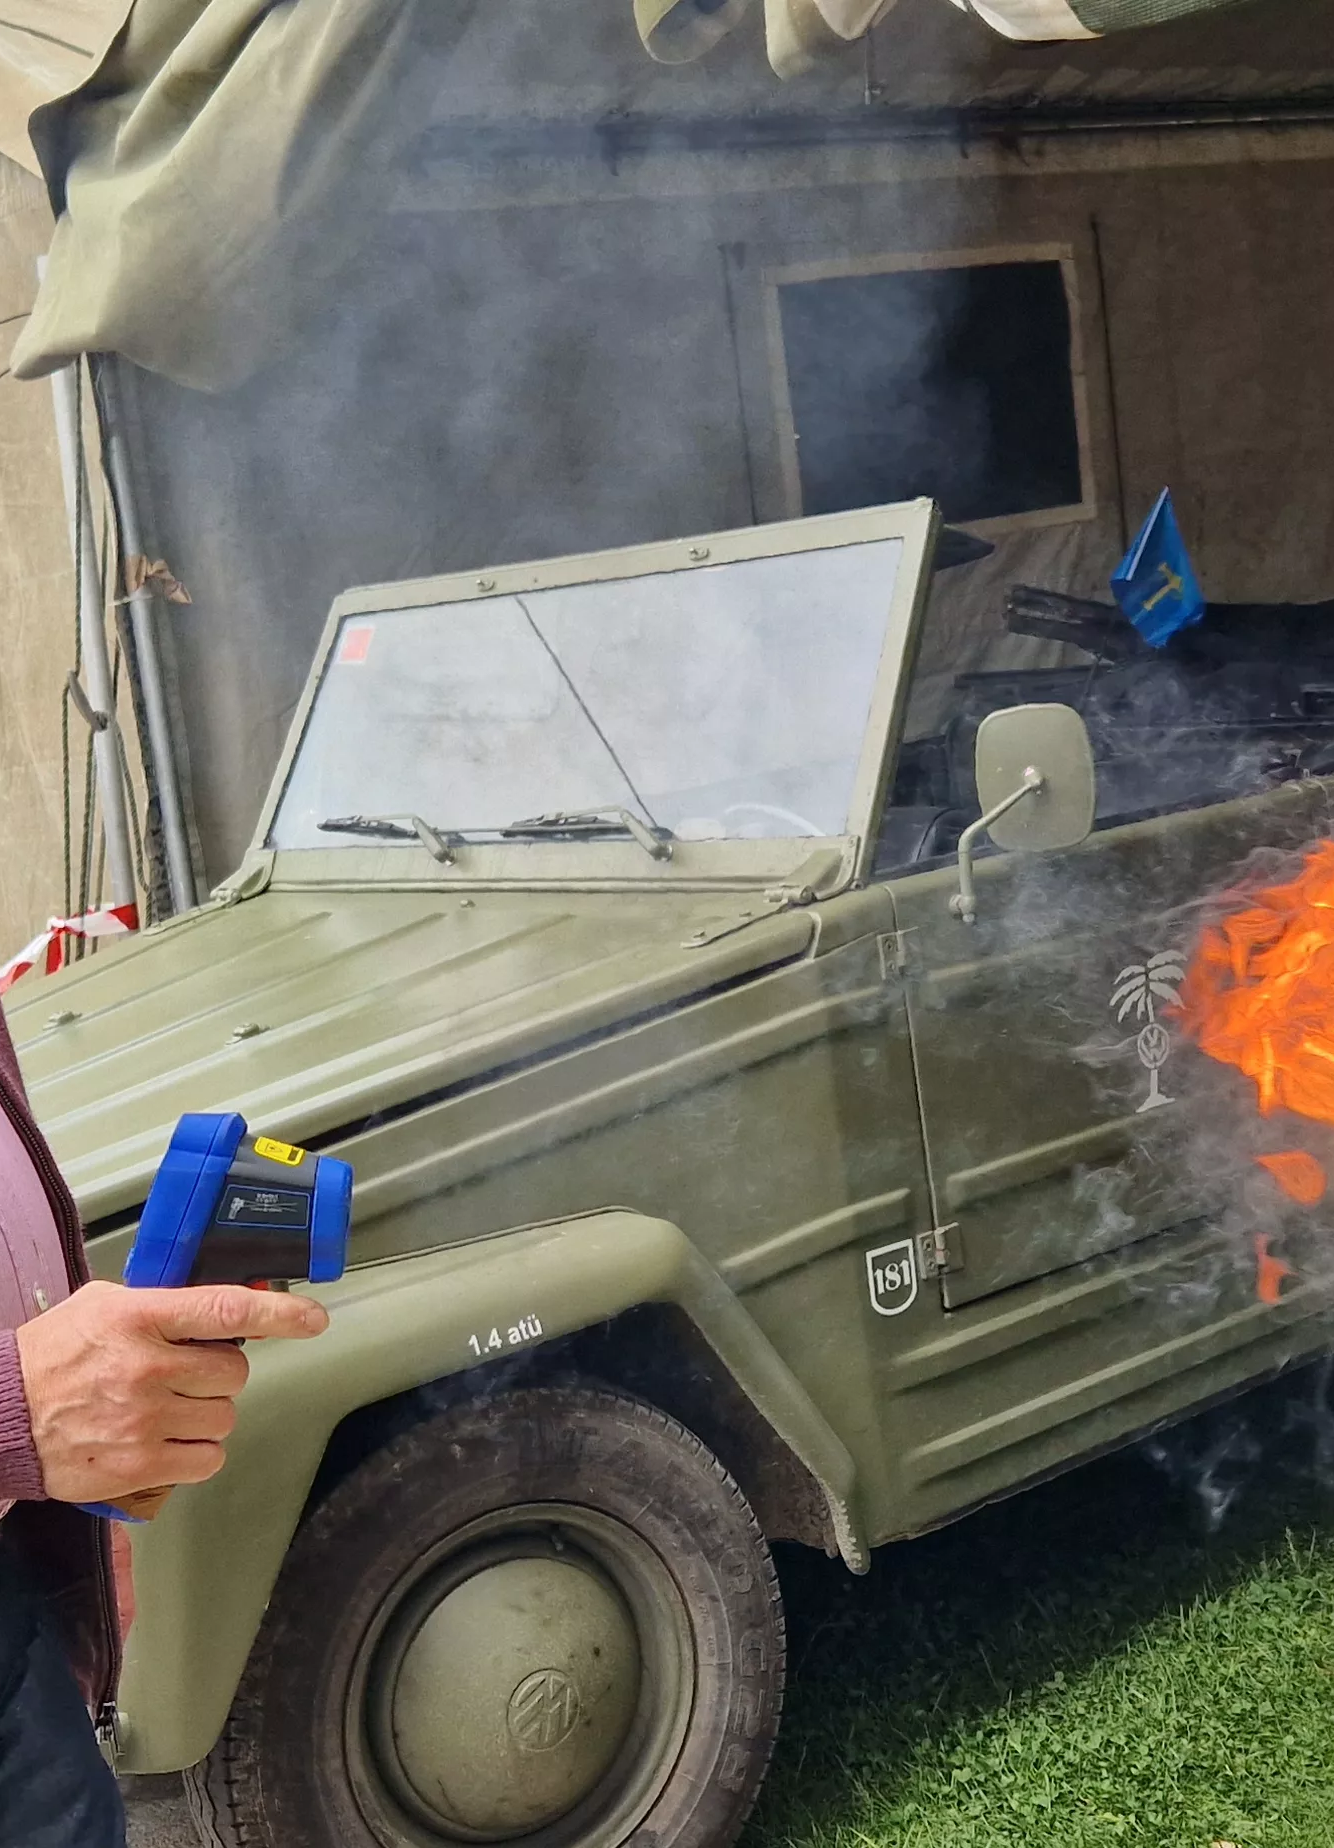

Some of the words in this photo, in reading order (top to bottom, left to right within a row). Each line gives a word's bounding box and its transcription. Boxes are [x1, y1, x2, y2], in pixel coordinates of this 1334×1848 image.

[874, 1259, 911, 1295] 181
[468, 1327, 503, 1356] 1.4
[507, 1313, 543, 1345] atü
